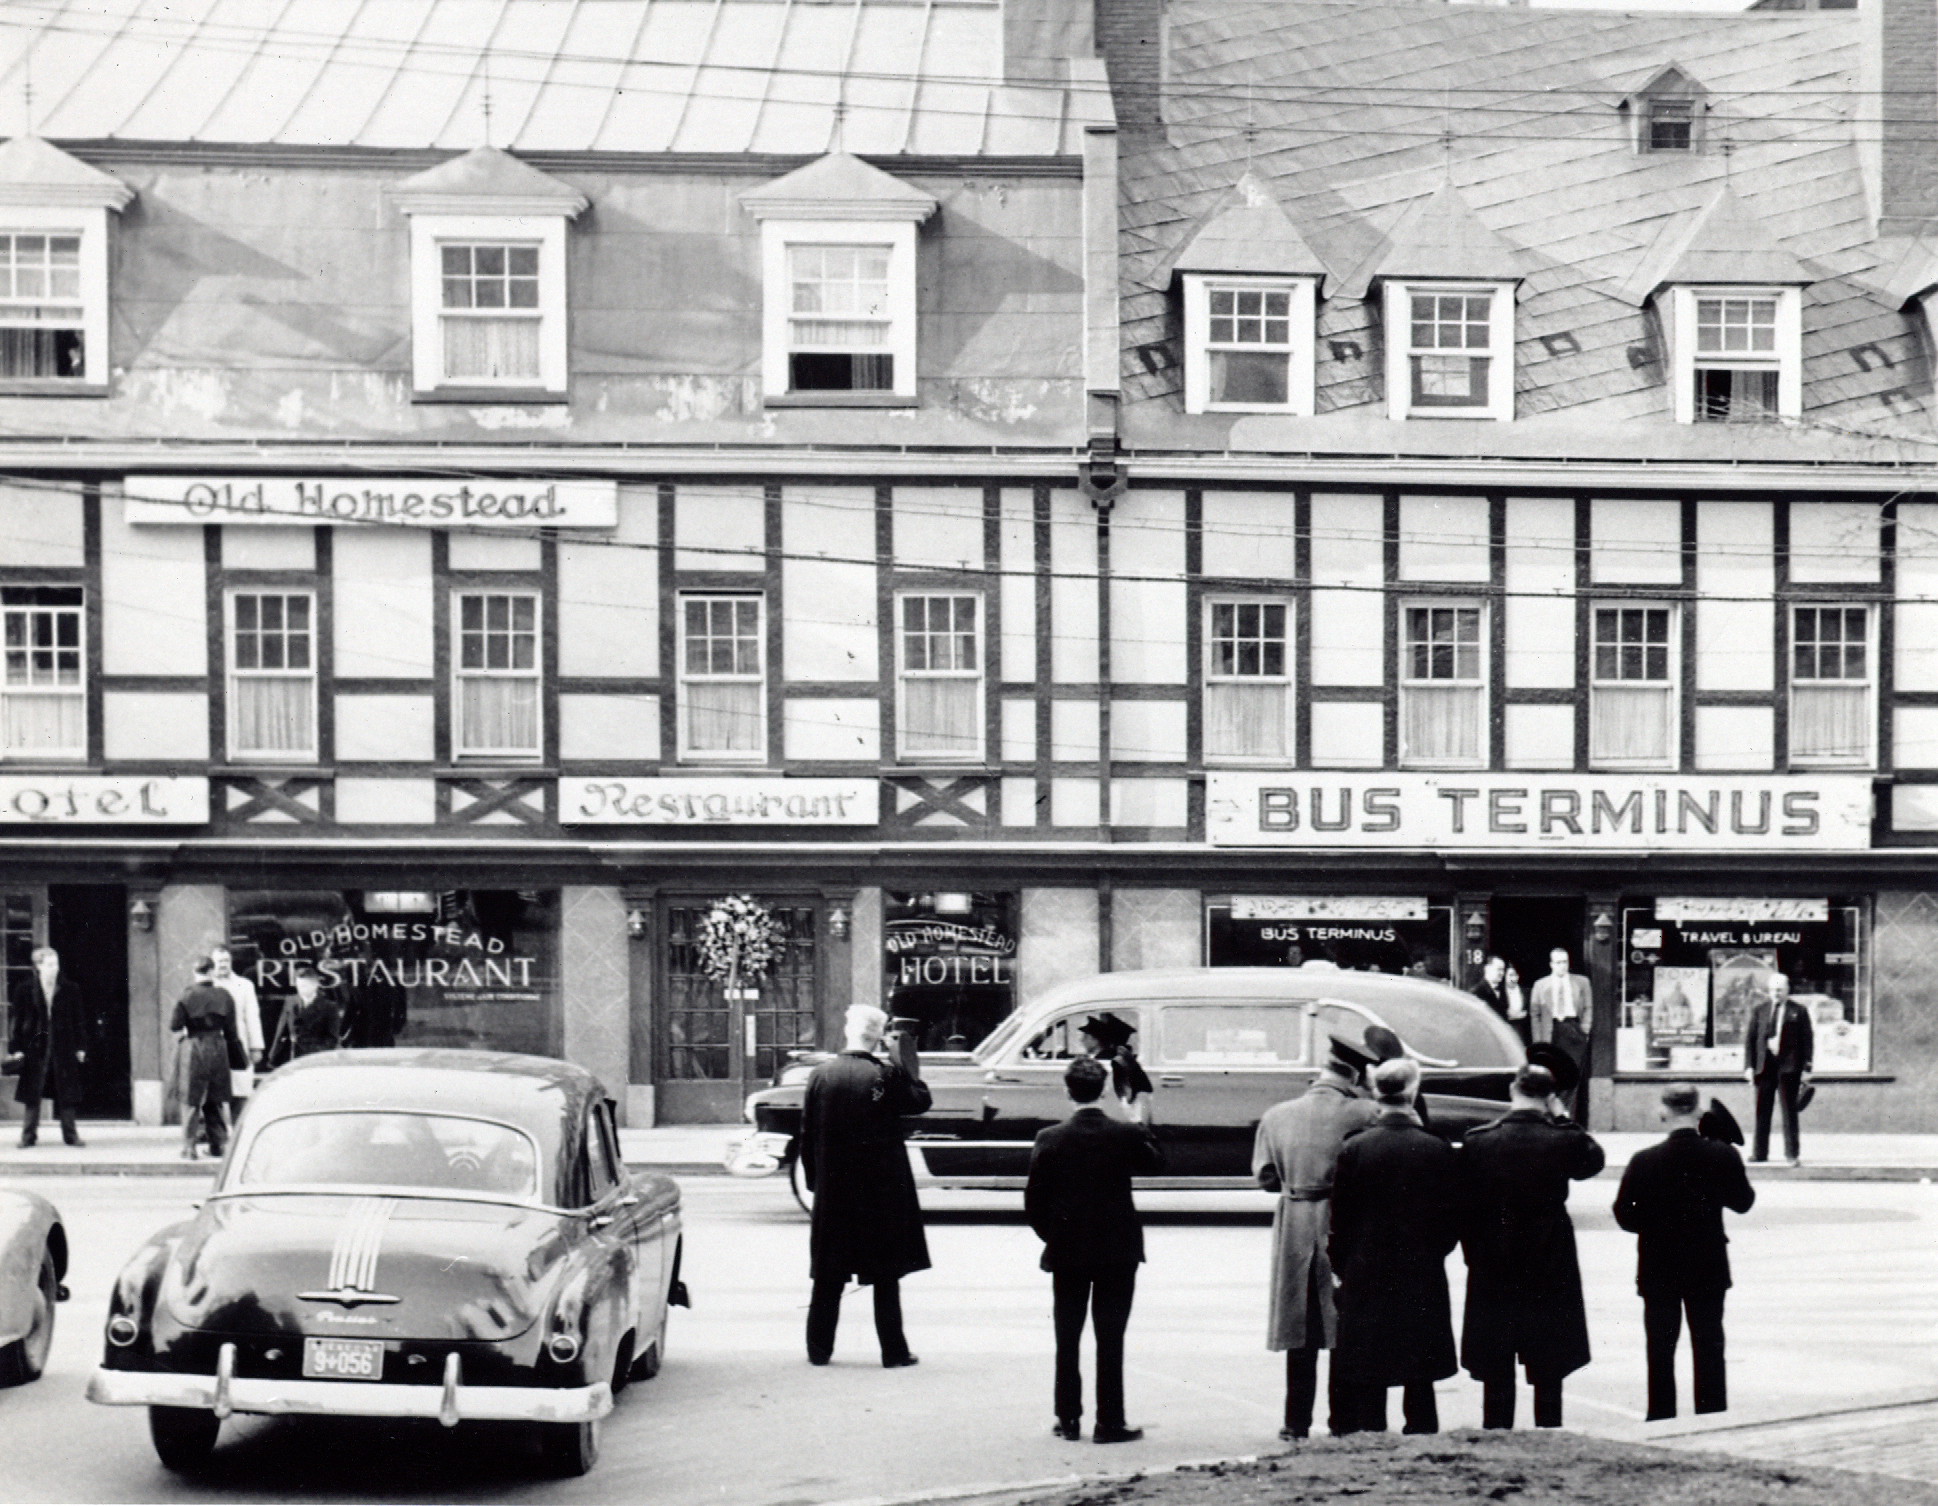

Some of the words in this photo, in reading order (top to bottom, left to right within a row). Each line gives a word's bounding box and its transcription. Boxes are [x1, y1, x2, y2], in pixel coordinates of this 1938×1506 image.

[184, 483, 270, 517] Old
[11, 781, 168, 821] otel
[579, 783, 858, 821] Restaurant
[1258, 787, 1401, 832] BUS
[1437, 788, 1821, 836] TERMINUS
[279, 930, 327, 955] OLD
[336, 923, 505, 955] HOMESTEAD
[1260, 927, 1299, 941] BUS
[1306, 927, 1396, 942] TERMINUS
[1680, 931, 1738, 944] TRAVEL
[1742, 932, 1801, 944] BUREAU
[256, 957, 537, 988] RESTAURANT
[900, 956, 1011, 985] HOTEL
[1466, 950, 1484, 965] 18
